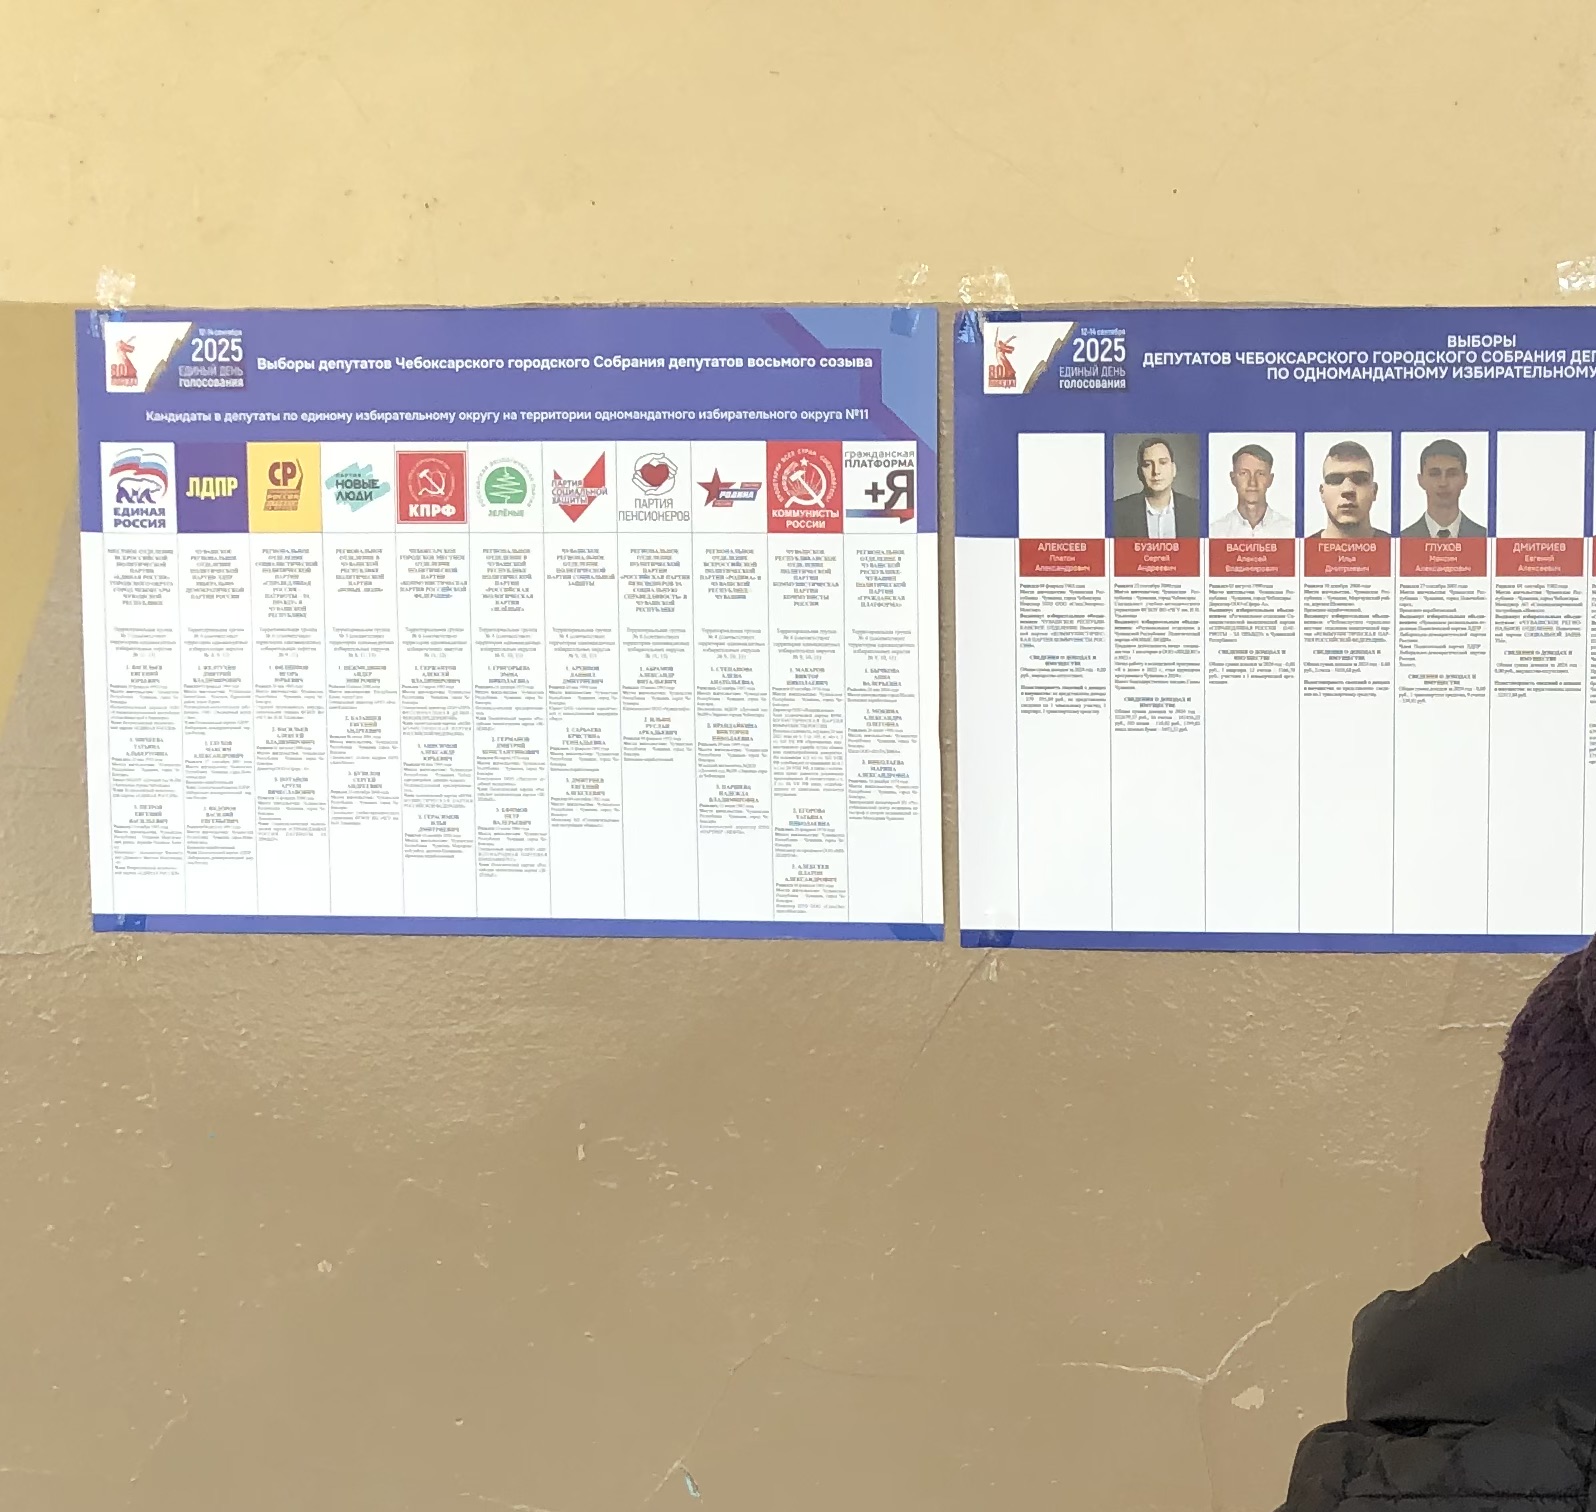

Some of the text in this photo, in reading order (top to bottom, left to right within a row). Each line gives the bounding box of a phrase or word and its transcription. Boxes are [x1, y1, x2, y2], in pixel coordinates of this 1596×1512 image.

[1448, 335, 1516, 347] ВЫБОРЫ
[191, 338, 242, 362] 2025
[1073, 338, 1125, 362] 2025
[257, 355, 872, 373] Выборы депутатов Чебоксарского городского Собрания депутатов восьмого созыва
[1143, 352, 1231, 368] ДЕПУТАТОВ
[1236, 351, 1368, 364] ЧЕБОКСАРСКОГО
[1373, 351, 1477, 366] ГОРОДСКОГО
[1482, 350, 1566, 362] СОБРАНИЯ
[1060, 365, 1125, 378] ЕДИНЫЙ ДЕНЬ
[1268, 367, 1289, 379] ПО
[1294, 366, 1448, 382] ОДНОМАНДАТНОМУ
[180, 378, 243, 387] голосования
[1060, 379, 1125, 388] голосования
[146, 410, 211, 423] Кандидаты
[214, 413, 221, 421] в
[224, 412, 280, 424] депутаты
[301, 413, 353, 423] единому
[356, 410, 456, 423] избирательному
[459, 412, 500, 423] округу
[503, 412, 517, 420] на
[520, 412, 591, 422] территории
[595, 411, 695, 421] одномандатного
[699, 408, 797, 421] избирательного
[801, 411, 842, 422] округа
[845, 451, 914, 459] гражданская
[845, 458, 914, 468] ПЛАТФОРМА
[269, 462, 296, 486] СР
[186, 477, 238, 500] ЛДПР
[336, 479, 379, 489] НОВЫЕ
[336, 491, 372, 501] ЛЮДИ
[551, 486, 608, 496] СОЦИАЛЬНОЙ
[719, 490, 755, 499] РОДИНА
[551, 496, 588, 505] ЗАЩИТЫ
[635, 498, 673, 508] ПАРТИЯ
[114, 508, 165, 517] ЕДИНАЯ
[409, 504, 456, 517] КПРФ
[772, 507, 839, 517] КОММУНИСТЫ
[618, 511, 690, 522] ПЕНСИОНЕРОВ
[114, 519, 166, 528] РОССИЯ
[786, 520, 825, 528] РОССИИ
[1038, 543, 1086, 551] АЛЕКСЕЕВ
[1135, 543, 1179, 551] БУЗИЛОВ
[1227, 544, 1277, 552] ВАСИЛЬЕВ
[1319, 543, 1376, 552] ГЕРАСИМОВ
[1425, 543, 1461, 551] ГЛУХОВ
[1513, 543, 1566, 553] ДМИТРИЕВ
